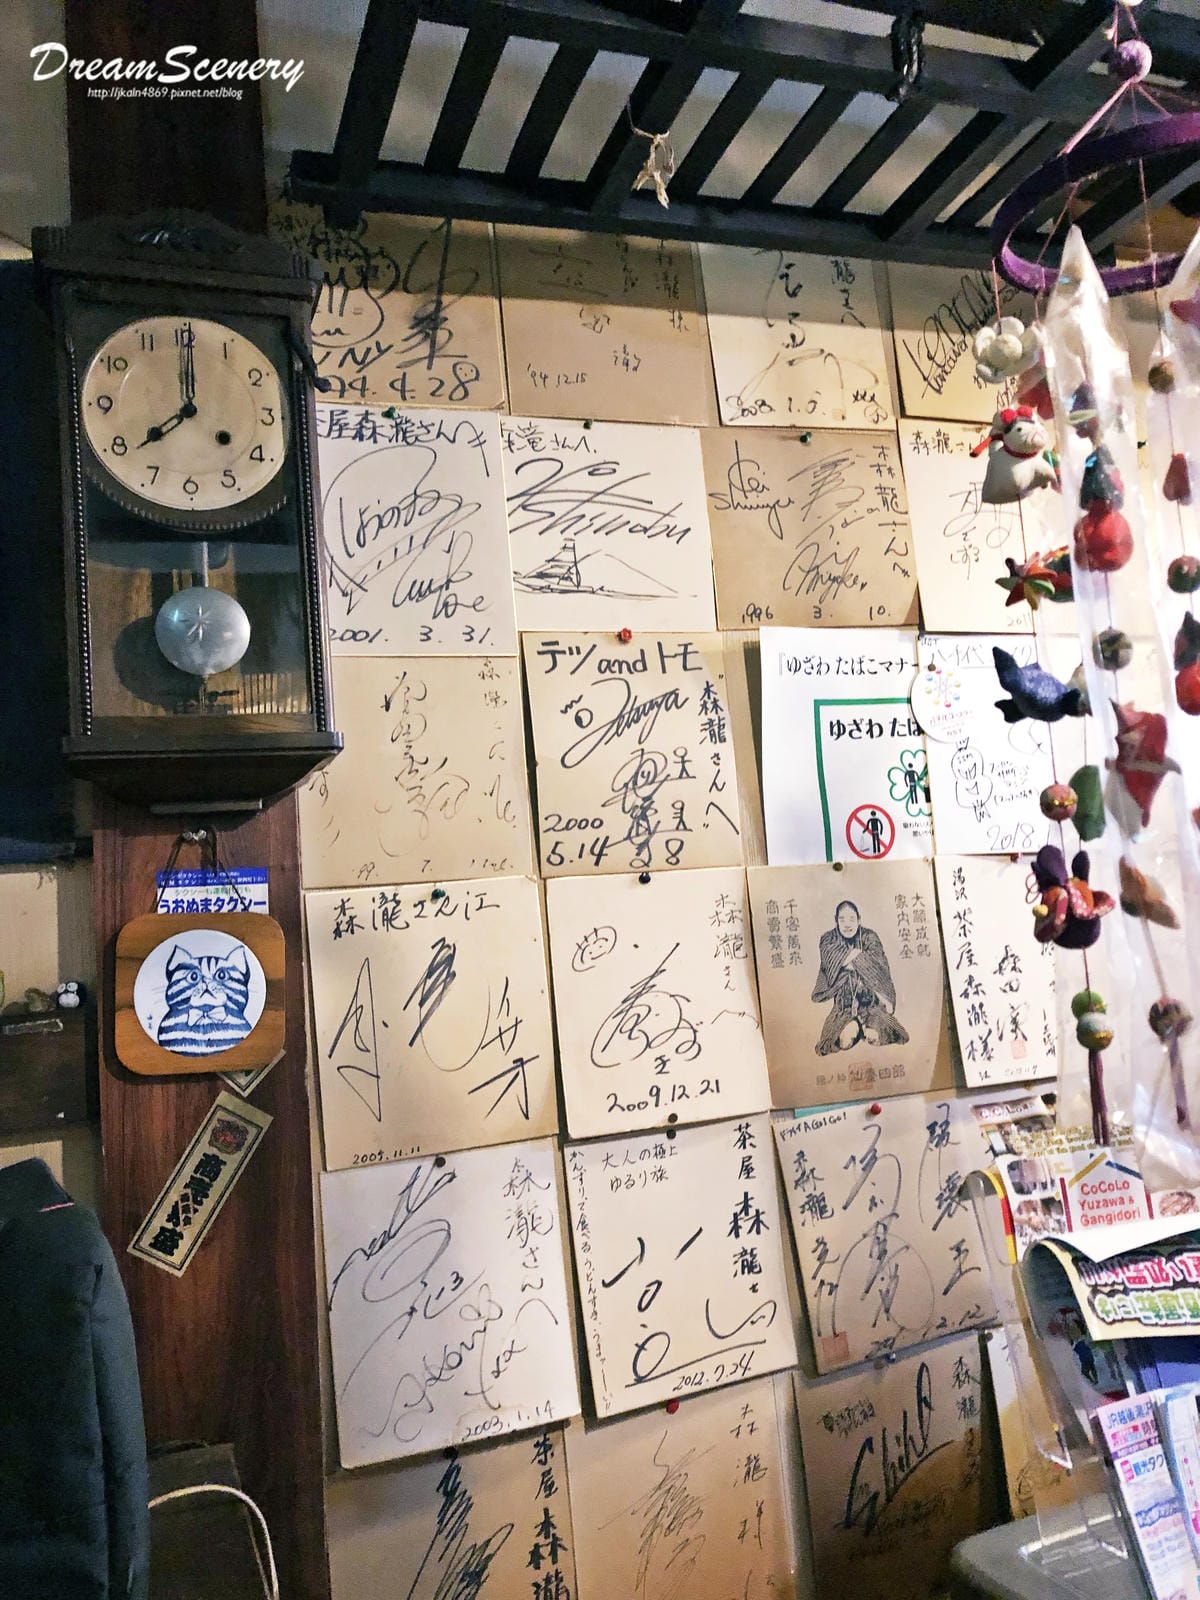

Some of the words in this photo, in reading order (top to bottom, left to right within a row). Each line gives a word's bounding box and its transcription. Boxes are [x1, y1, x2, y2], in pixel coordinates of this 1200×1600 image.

[140, 333, 154, 352] 11
[106, 355, 128, 374] 10
[248, 368, 263, 387] 2
[97, 395, 113, 415] 9
[260, 407, 275, 426] 3
[110, 436, 128, 456] 8
[250, 444, 266, 462] 4
[146, 466, 160, 485] 7
[221, 470, 237, 488] 5
[183, 476, 199, 495] 6
[597, 649, 649, 675] and
[829, 718, 884, 741] ゆざわ
[1079, 1196, 1126, 1211] Yuzawa
[1080, 1208, 1141, 1227] Gangidori
